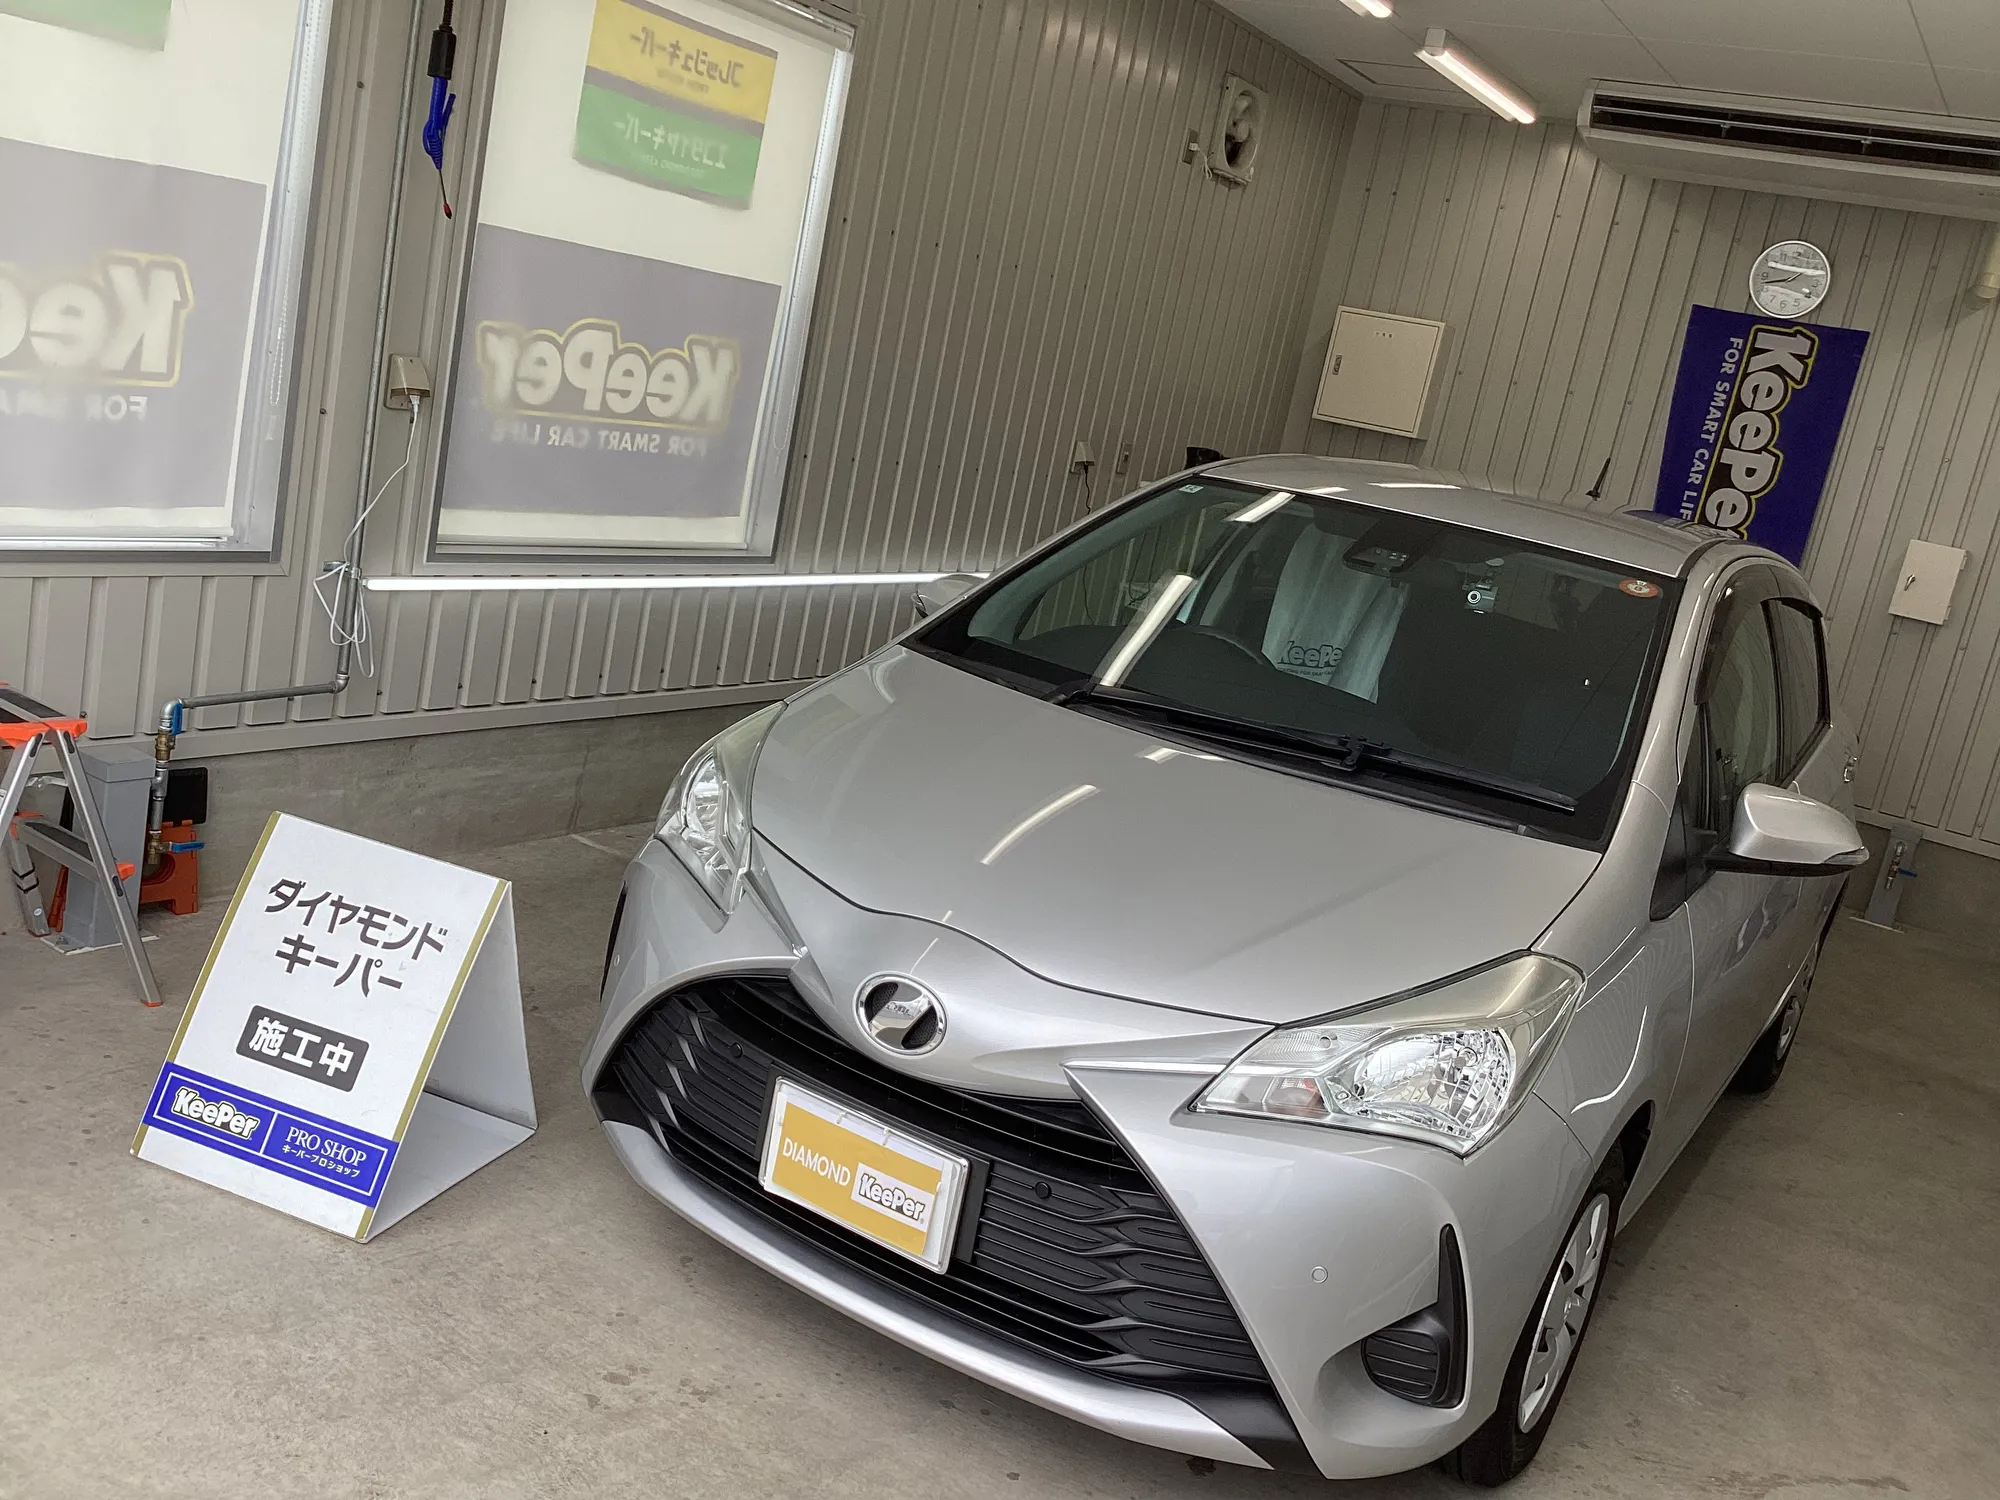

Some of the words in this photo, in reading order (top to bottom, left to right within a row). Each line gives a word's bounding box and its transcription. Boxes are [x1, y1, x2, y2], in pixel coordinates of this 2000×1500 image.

[1761, 271, 1769, 281] 9
[1811, 279, 1820, 288] 3
[1769, 295, 1776, 303] 7
[1779, 299, 1787, 309] 6
[1793, 298, 1801, 307] 5
[1719, 337, 1744, 375] FOR
[1700, 380, 1730, 443] SMART
[1705, 331, 1812, 539] KeePe
[1686, 448, 1709, 484] CAR
[1679, 490, 1698, 521] LIF
[1279, 640, 1343, 669] KeePe
[264, 877, 448, 961] ダイヤモンド
[274, 933, 403, 998] キーパー
[248, 1014, 355, 1078] 施工中
[173, 1087, 260, 1139] KeePer
[285, 1125, 321, 1151] PRO
[320, 1138, 367, 1168] SHOP
[782, 1136, 851, 1188] DIAMOND
[858, 1172, 926, 1221] KeePer
